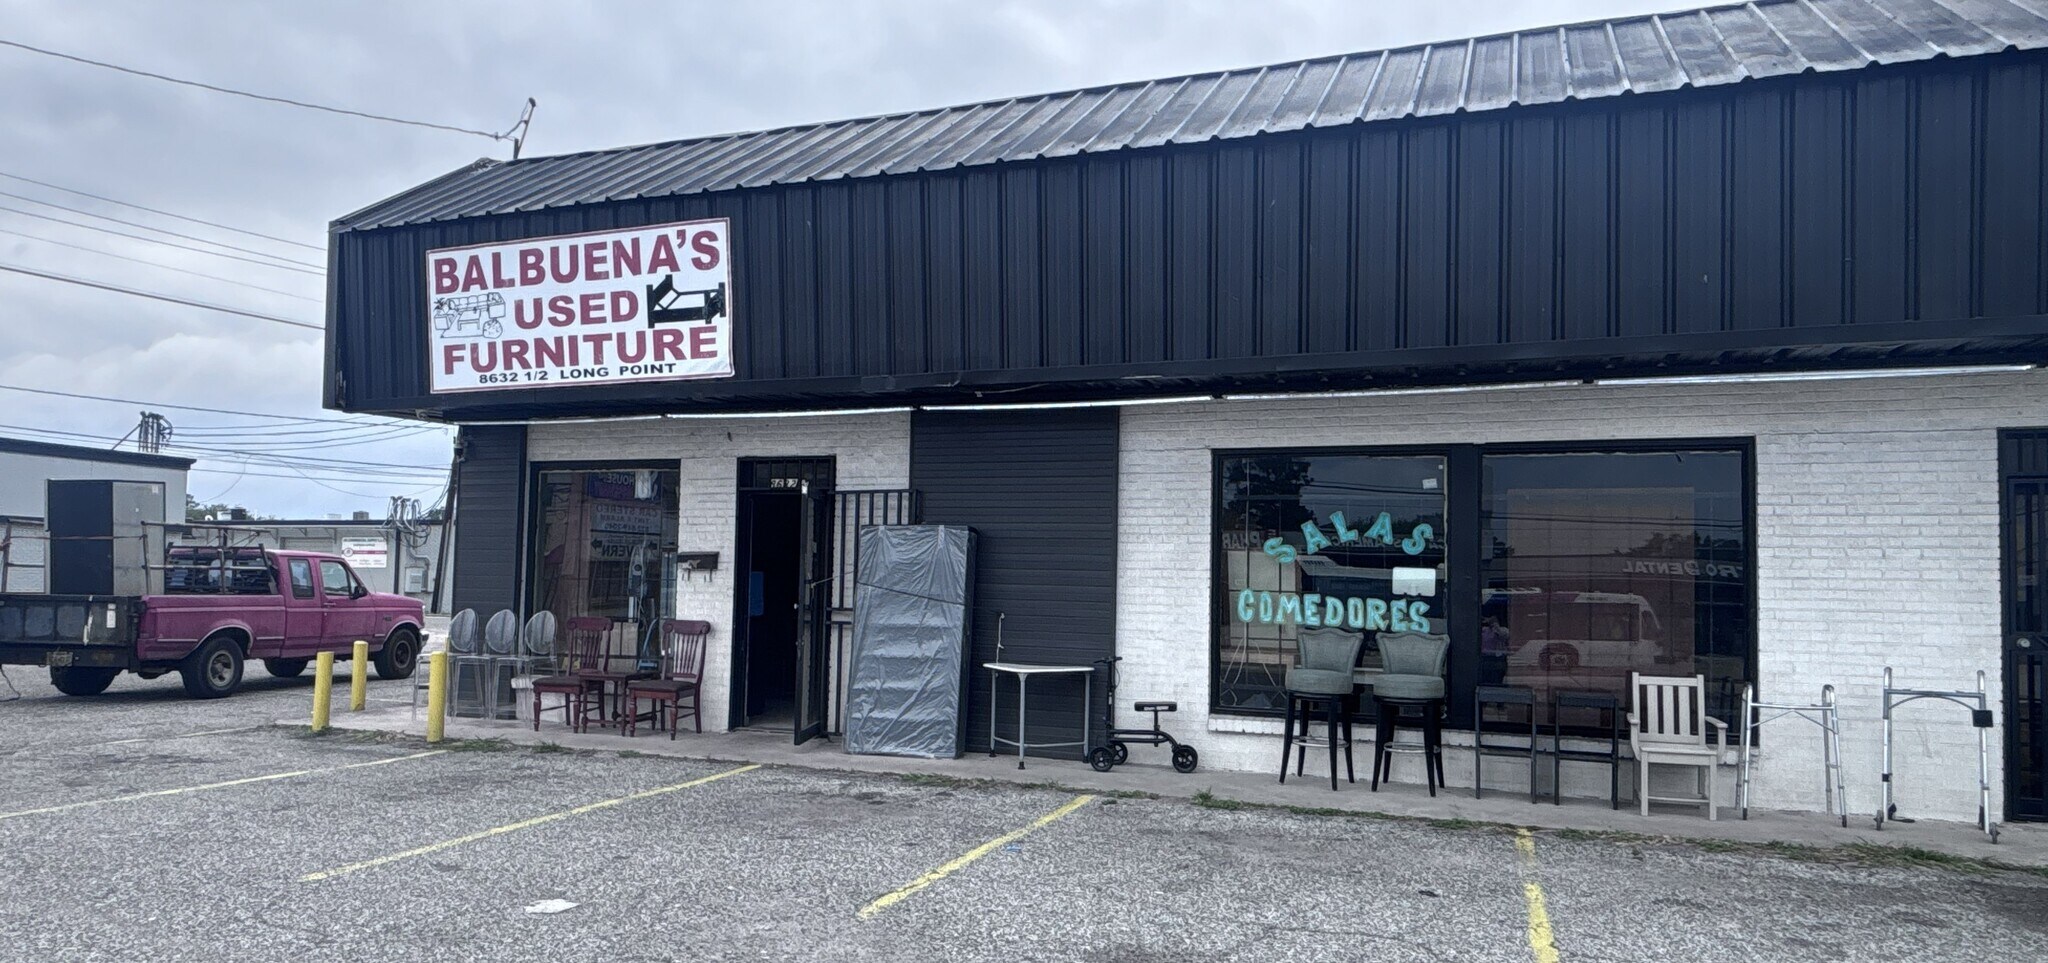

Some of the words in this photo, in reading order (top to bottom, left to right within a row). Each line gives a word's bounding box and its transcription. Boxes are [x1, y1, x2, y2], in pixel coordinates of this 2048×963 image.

[433, 229, 721, 295] BALBUENA'S
[514, 290, 639, 330] USED
[443, 325, 718, 375] FURNITURE
[479, 371, 518, 384] 8632
[524, 370, 549, 381] 1/2
[560, 367, 609, 379] LONG
[619, 363, 677, 376] POINT
[1263, 511, 1434, 563] SALAS
[1238, 589, 1430, 634] COMEDORES
